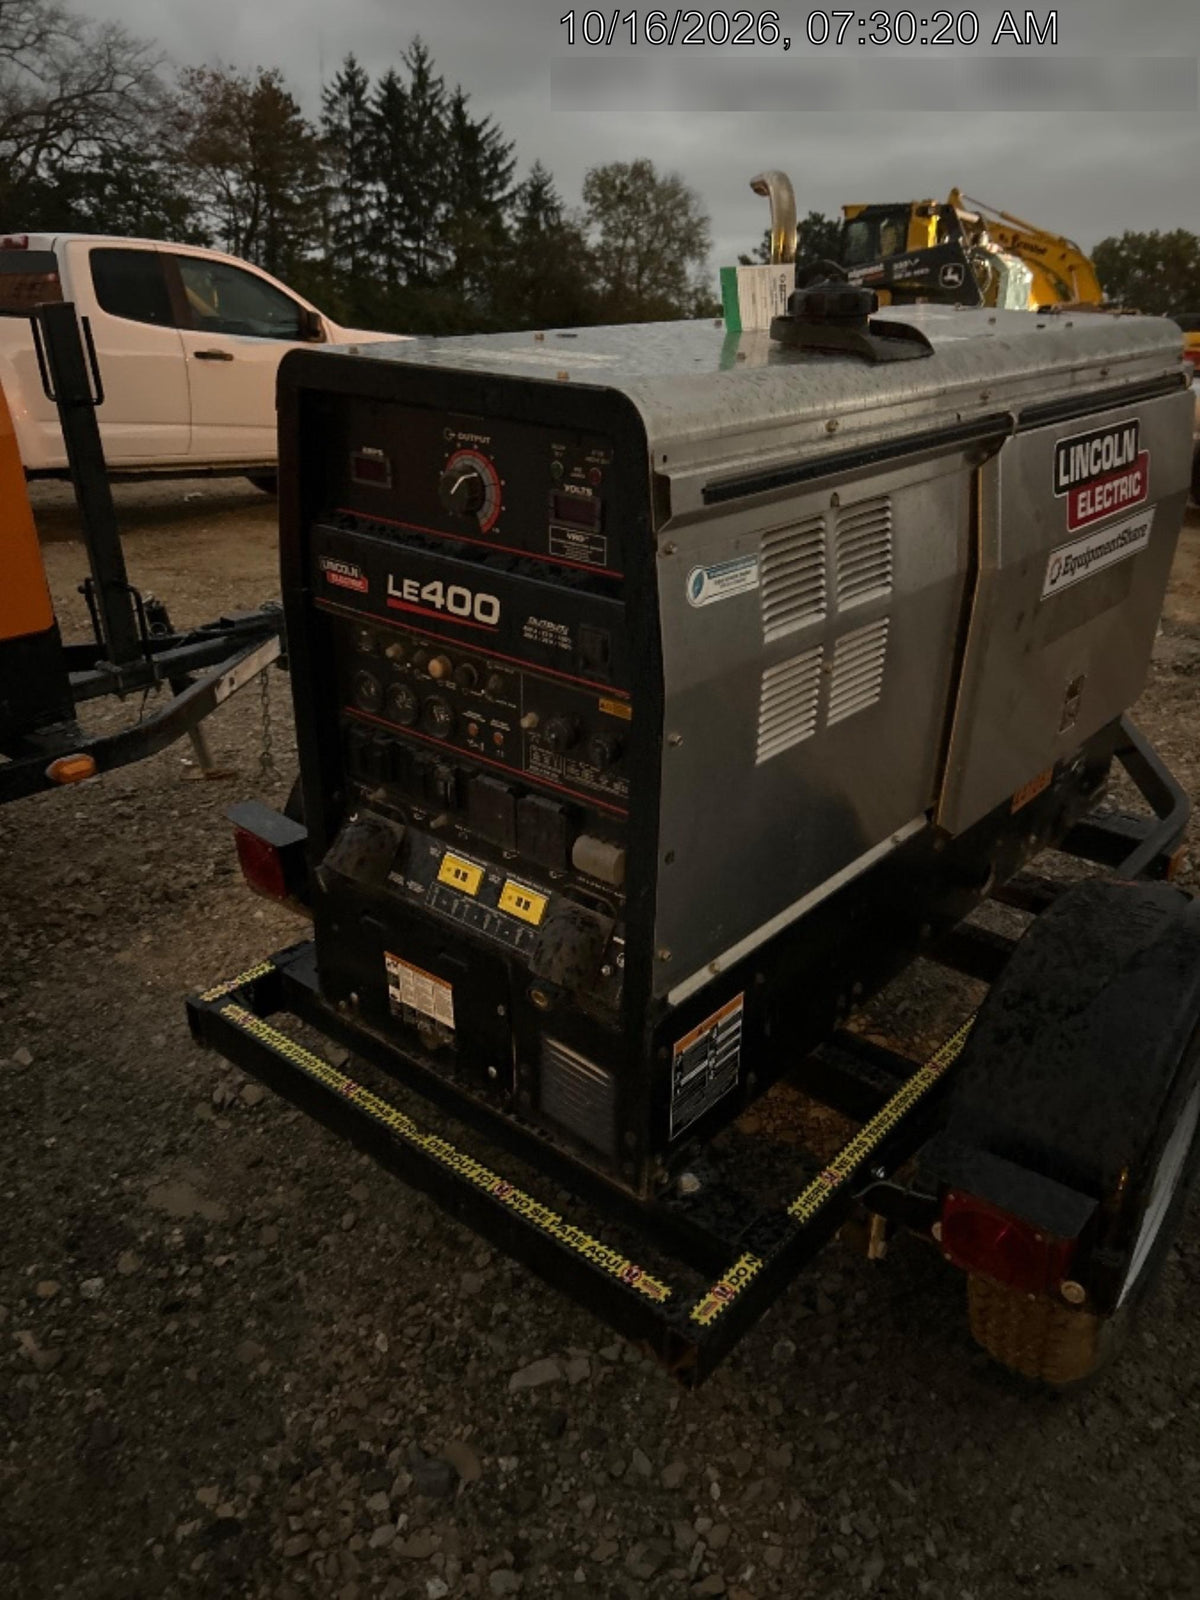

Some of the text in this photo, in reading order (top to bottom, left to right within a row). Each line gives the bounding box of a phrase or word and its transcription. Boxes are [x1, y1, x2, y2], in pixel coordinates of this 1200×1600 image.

[458, 432, 492, 444] OUTPUT
[1059, 428, 1136, 486] LINCOLN
[1077, 471, 1141, 520] ELECTRIC
[322, 558, 360, 578] LINCOLN
[1062, 523, 1147, 577] EquipmentShare
[387, 574, 501, 625] LE400
[799, 1182, 826, 1209] HERE
[833, 1155, 849, 1172] NE
[846, 1137, 866, 1158] PAS
[427, 1137, 476, 1174] DEBOUT
[476, 1170, 496, 1187] ICI
[509, 1191, 530, 1209] NO
[530, 1205, 548, 1221] SE
[548, 1217, 588, 1247] PARE
[585, 1242, 623, 1270] AQUI
[726, 1264, 749, 1287] DO
